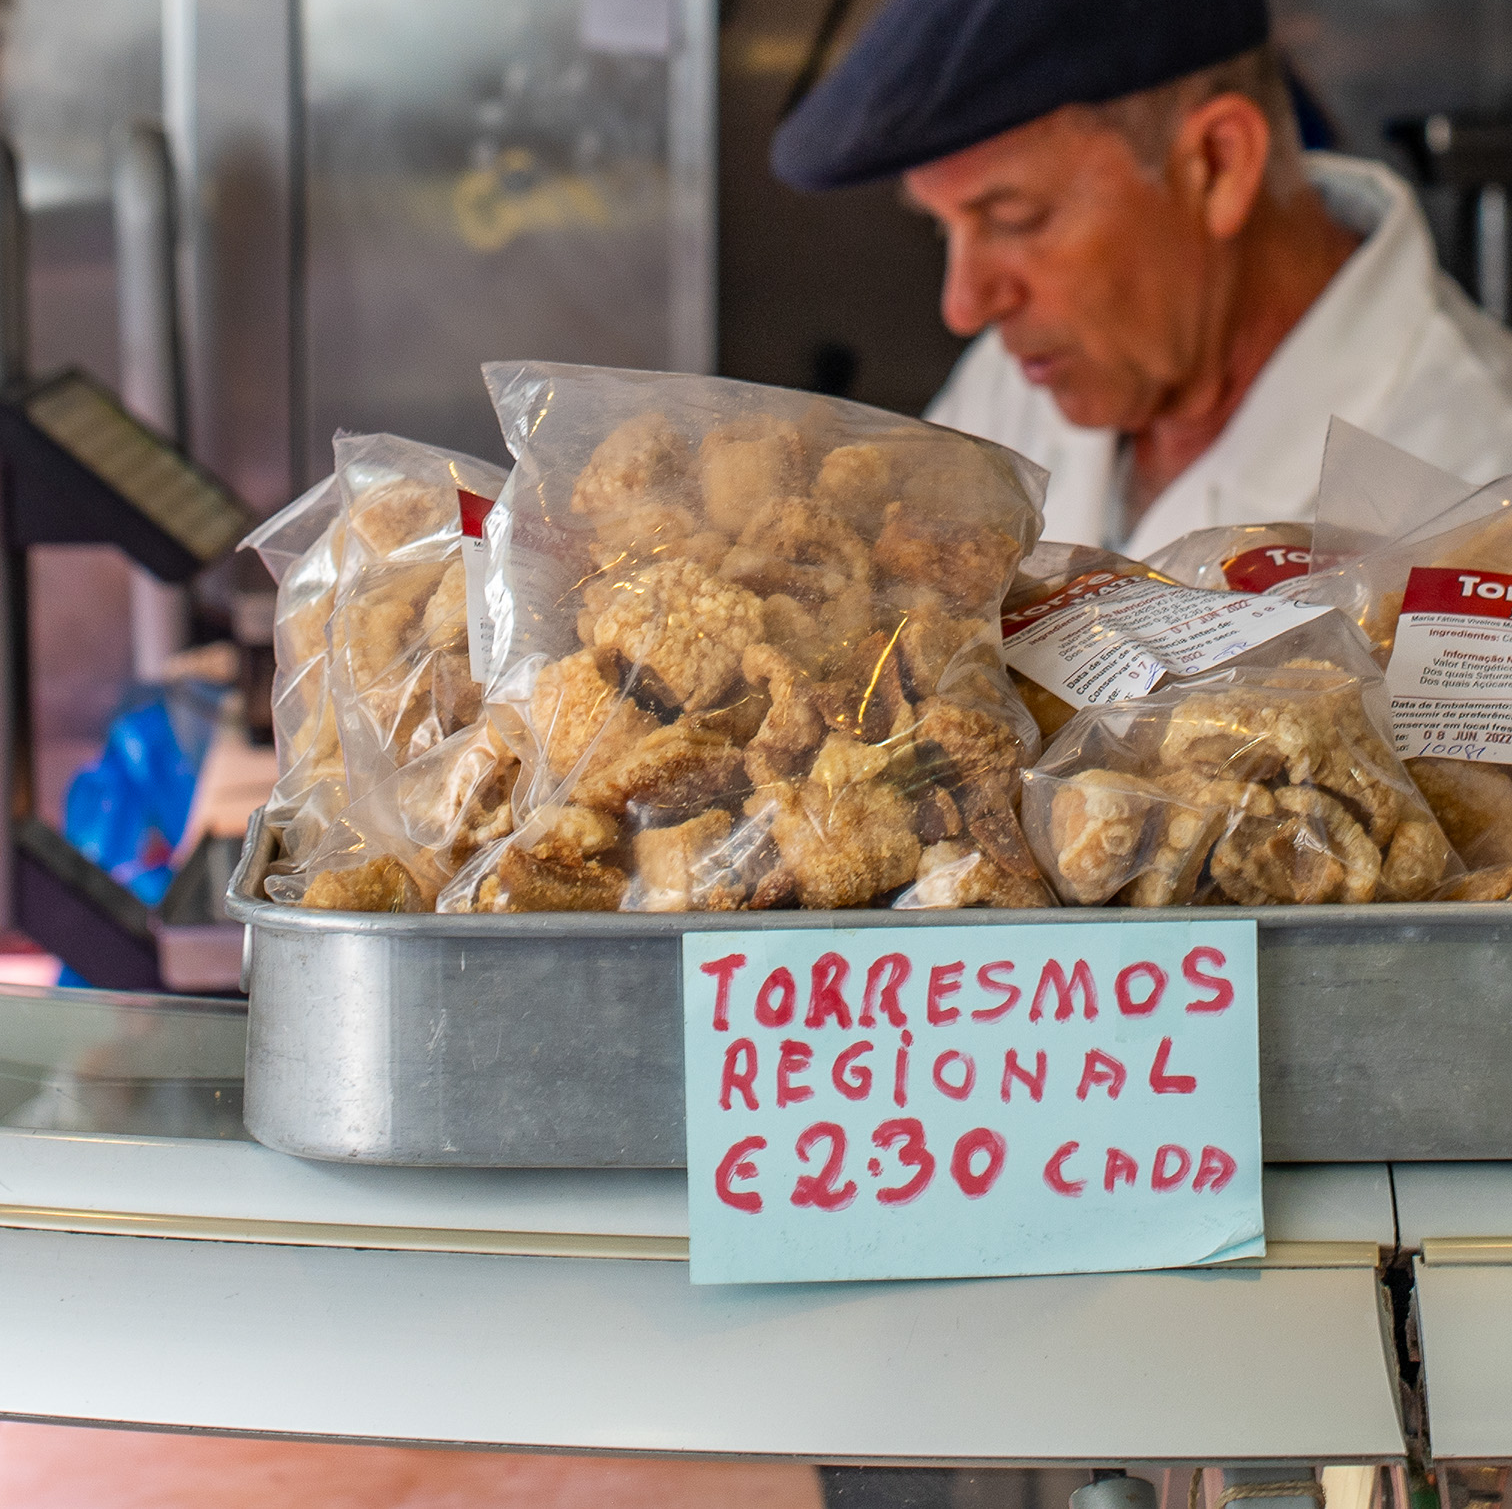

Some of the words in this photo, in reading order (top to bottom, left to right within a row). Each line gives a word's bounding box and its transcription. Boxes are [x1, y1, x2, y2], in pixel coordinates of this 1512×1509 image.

[1411, 615, 1435, 623] Maria
[1436, 615, 1465, 624] Fátima
[1468, 618, 1500, 627] Viveiros
[1429, 628, 1500, 642] Ingredientes:
[1076, 659, 1118, 695] Consumir
[1188, 627, 1217, 641] antes
[1443, 649, 1504, 663] Informação
[1433, 658, 1459, 669] Valor
[1066, 671, 1089, 689] Data
[1088, 660, 1101, 671] de
[1423, 666, 1442, 676] Dos
[1445, 669, 1473, 680] quais
[1088, 662, 1131, 703] Conservar
[1420, 676, 1439, 686] Dos
[1442, 679, 1470, 689] quais
[1391, 700, 1416, 709] Data
[1418, 701, 1432, 709] de
[1434, 701, 1512, 711] Embalamento:
[1442, 710, 1456, 718] de
[1393, 721, 1440, 730] onservar
[1463, 721, 1490, 731] local
[1484, 732, 1512, 744] 2022
[700, 946, 1235, 1032] TORRESMOS
[1043, 1139, 1239, 1198] CADA
